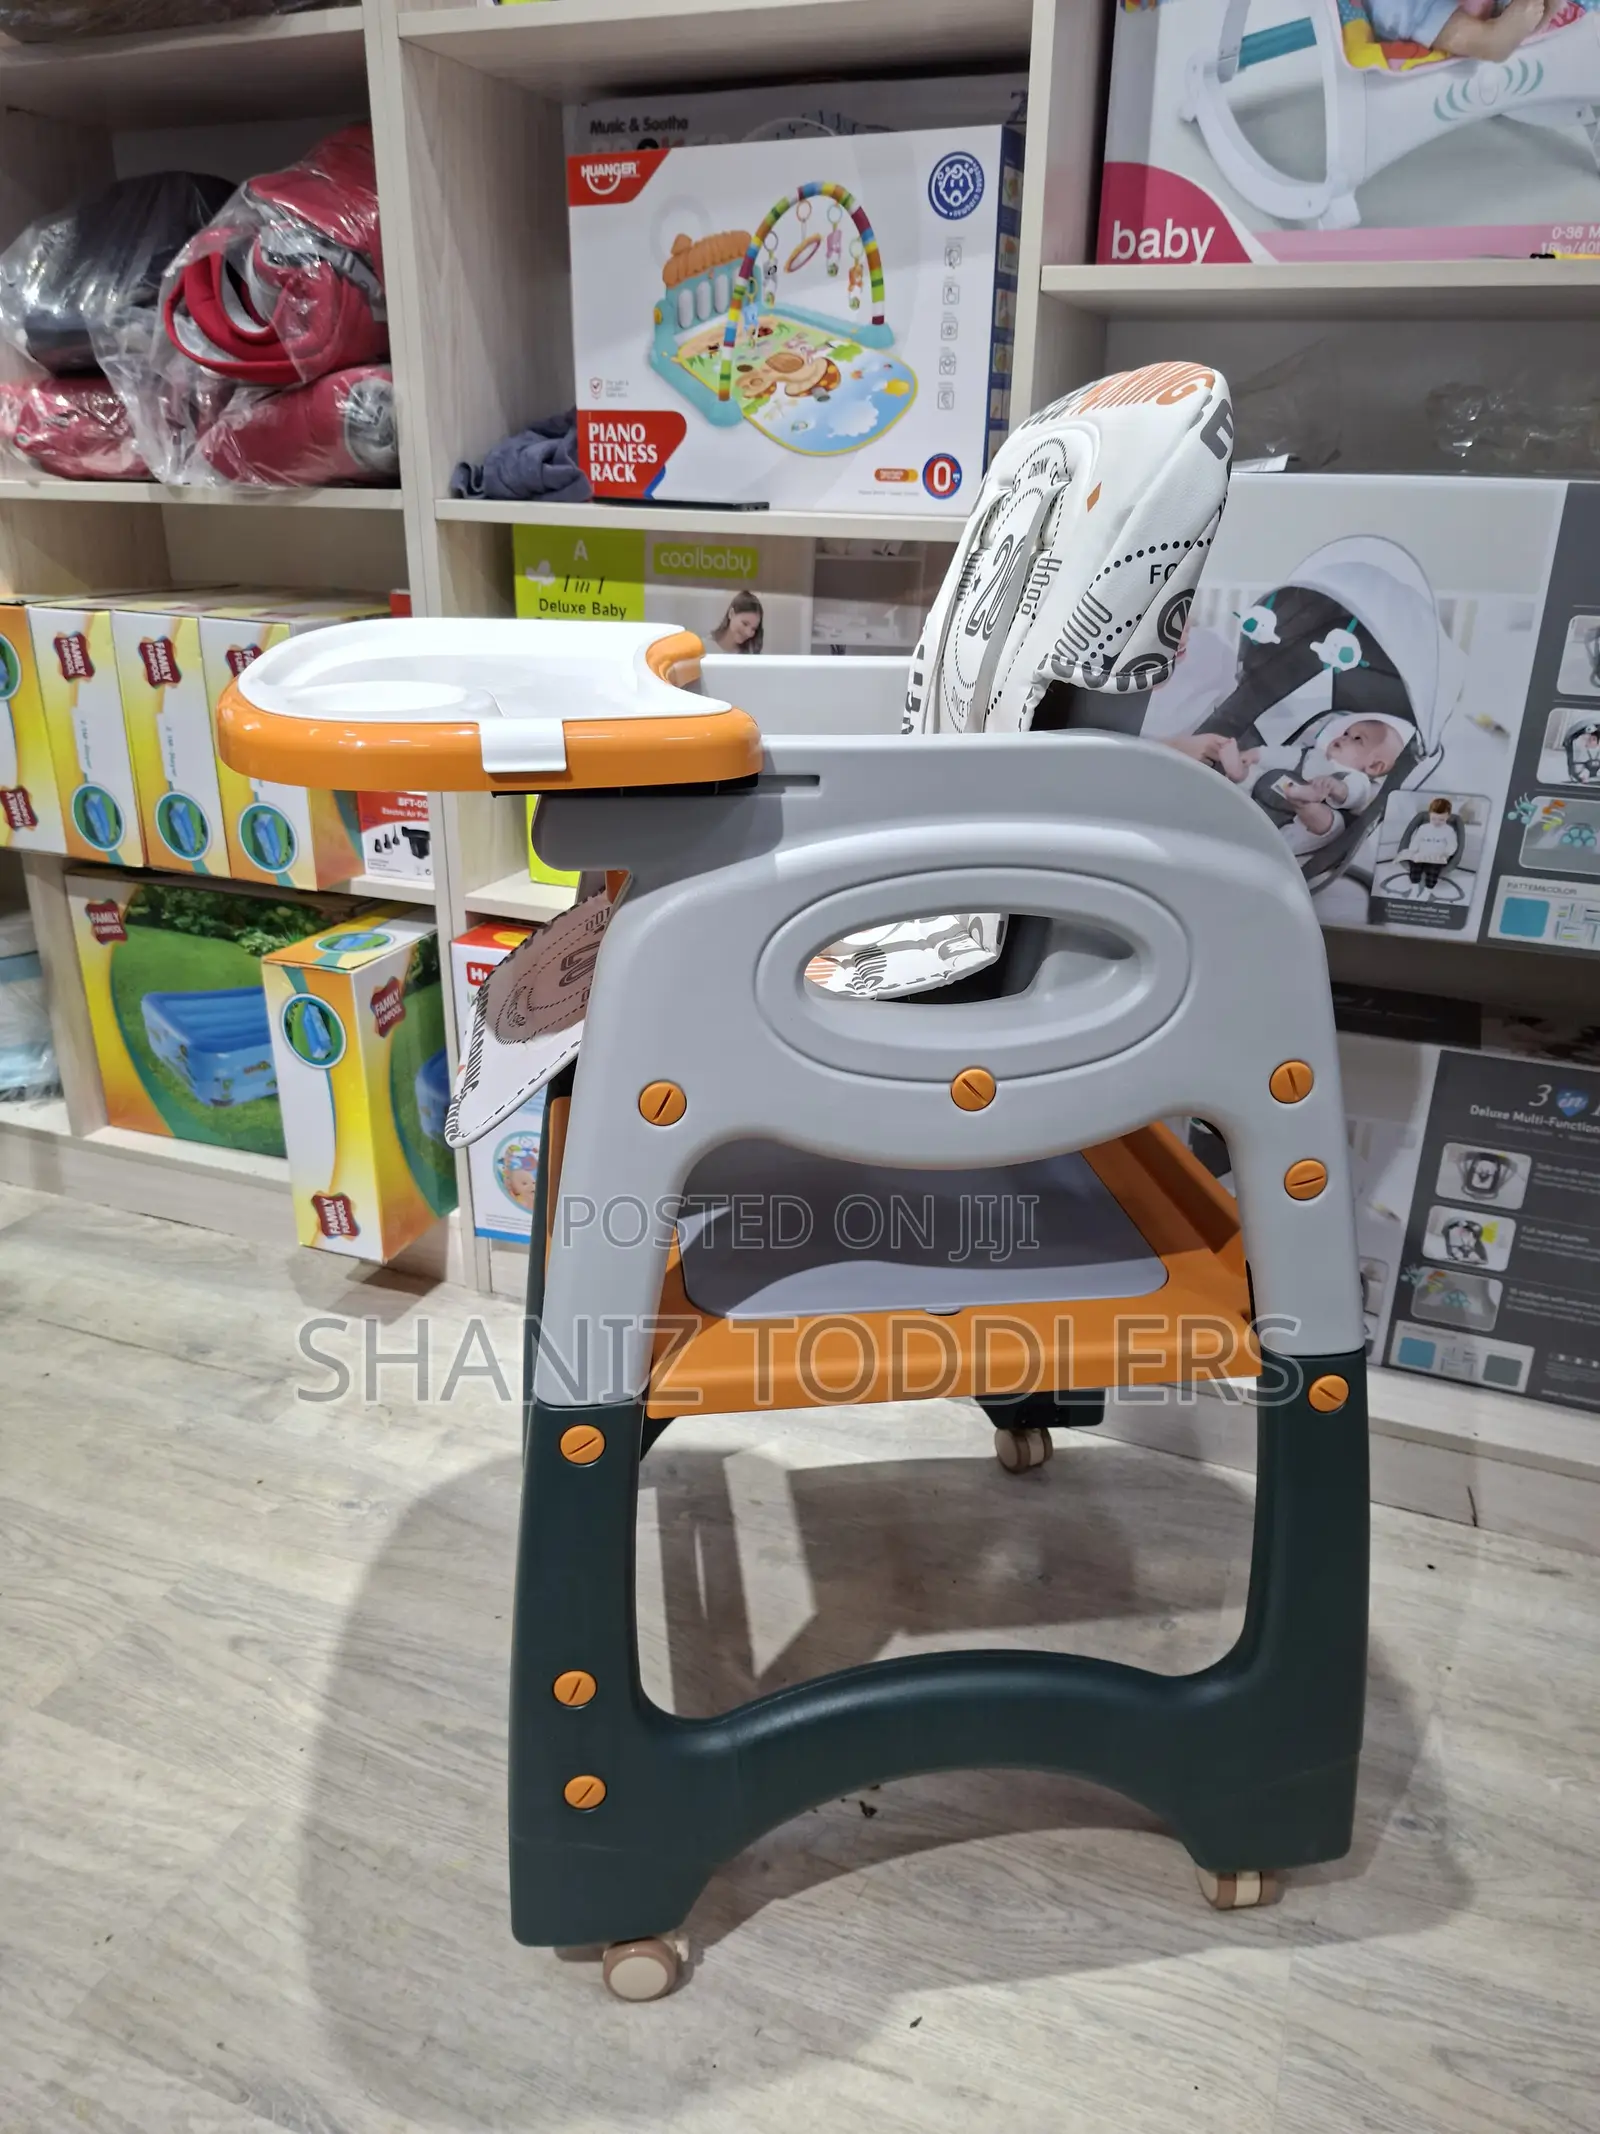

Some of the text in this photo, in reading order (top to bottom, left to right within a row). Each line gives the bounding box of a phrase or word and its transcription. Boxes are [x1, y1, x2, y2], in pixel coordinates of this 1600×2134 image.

[590, 117, 625, 135] Music
[629, 117, 640, 133] &
[581, 161, 637, 179] HUANGER
[1111, 218, 1216, 265] baby
[588, 421, 646, 443] PIANO
[589, 442, 658, 464] FITNESS
[590, 462, 637, 483] RACK
[933, 460, 952, 492] 0
[573, 538, 589, 561] A
[660, 546, 752, 578] coolbaby
[575, 575, 591, 594] in
[539, 598, 627, 621] Deluxe Baby
[68, 636, 87, 677] FAMILY
[154, 641, 174, 682] FAMILY
[90, 911, 120, 924] FAMILY
[375, 988, 399, 1018] FAMILY
[1528, 1083, 1553, 1107] 3
[1470, 1104, 1510, 1120] Deluxe
[322, 1198, 342, 1235] FAMILY
[335, 1200, 351, 1234] FUNPOOL
